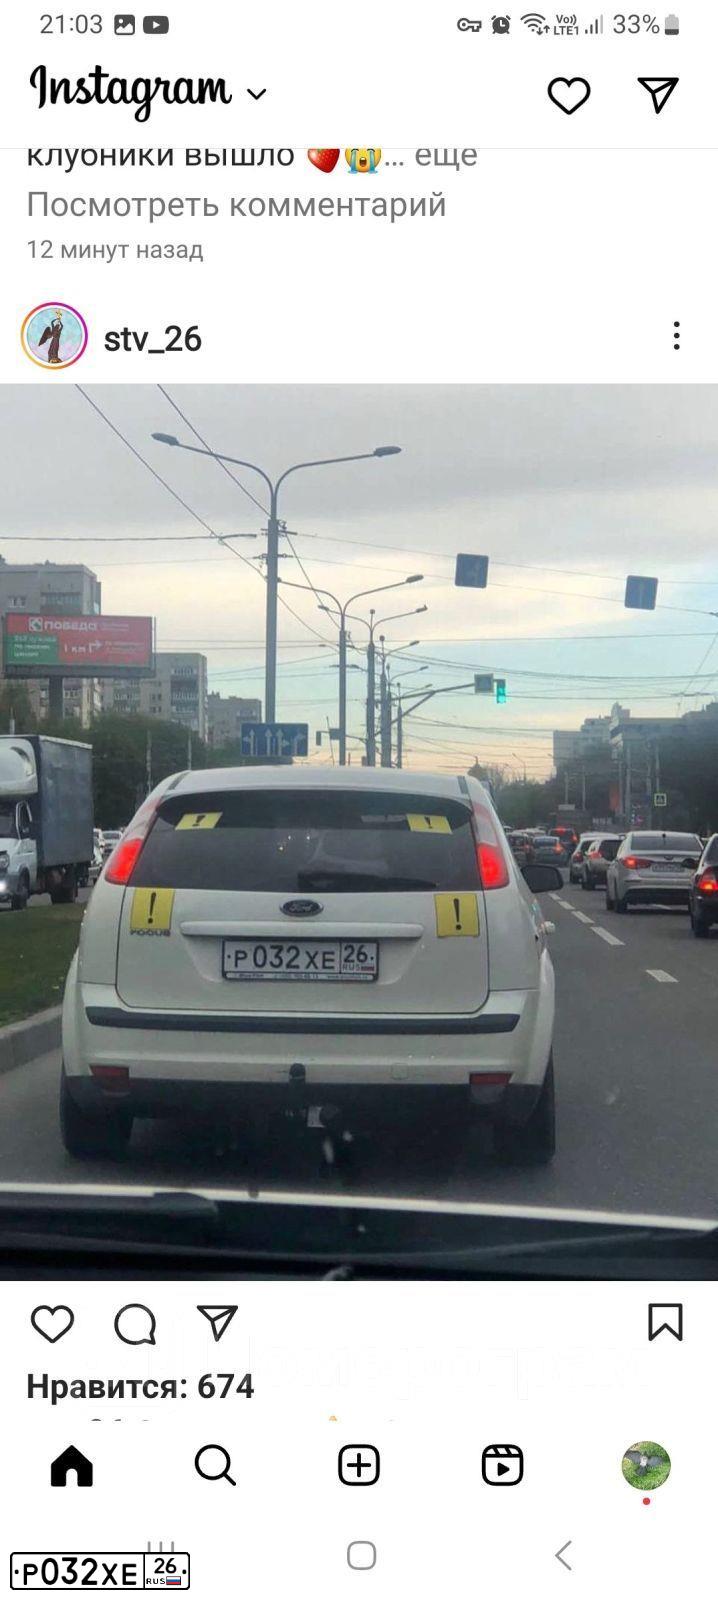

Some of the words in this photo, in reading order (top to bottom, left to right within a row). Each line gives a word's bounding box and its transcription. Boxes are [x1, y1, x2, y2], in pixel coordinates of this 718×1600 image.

[39, 14, 103, 34] 21:03
[553, 25, 579, 36] LTE1
[613, 14, 661, 34] 33%
[29, 64, 233, 123] Instagram
[185, 148, 295, 167] вышло
[28, 191, 219, 223] Посмотреть
[230, 191, 446, 223] комментарий
[28, 239, 54, 259] 12
[61, 244, 130, 264] минут
[136, 243, 204, 263] назад
[104, 324, 202, 355] stv_26
[147, 891, 157, 924] !
[453, 897, 462, 931] !
[343, 944, 369, 963] 26
[27, 1373, 187, 1405] Нравится:
[197, 1373, 255, 1399] 674
